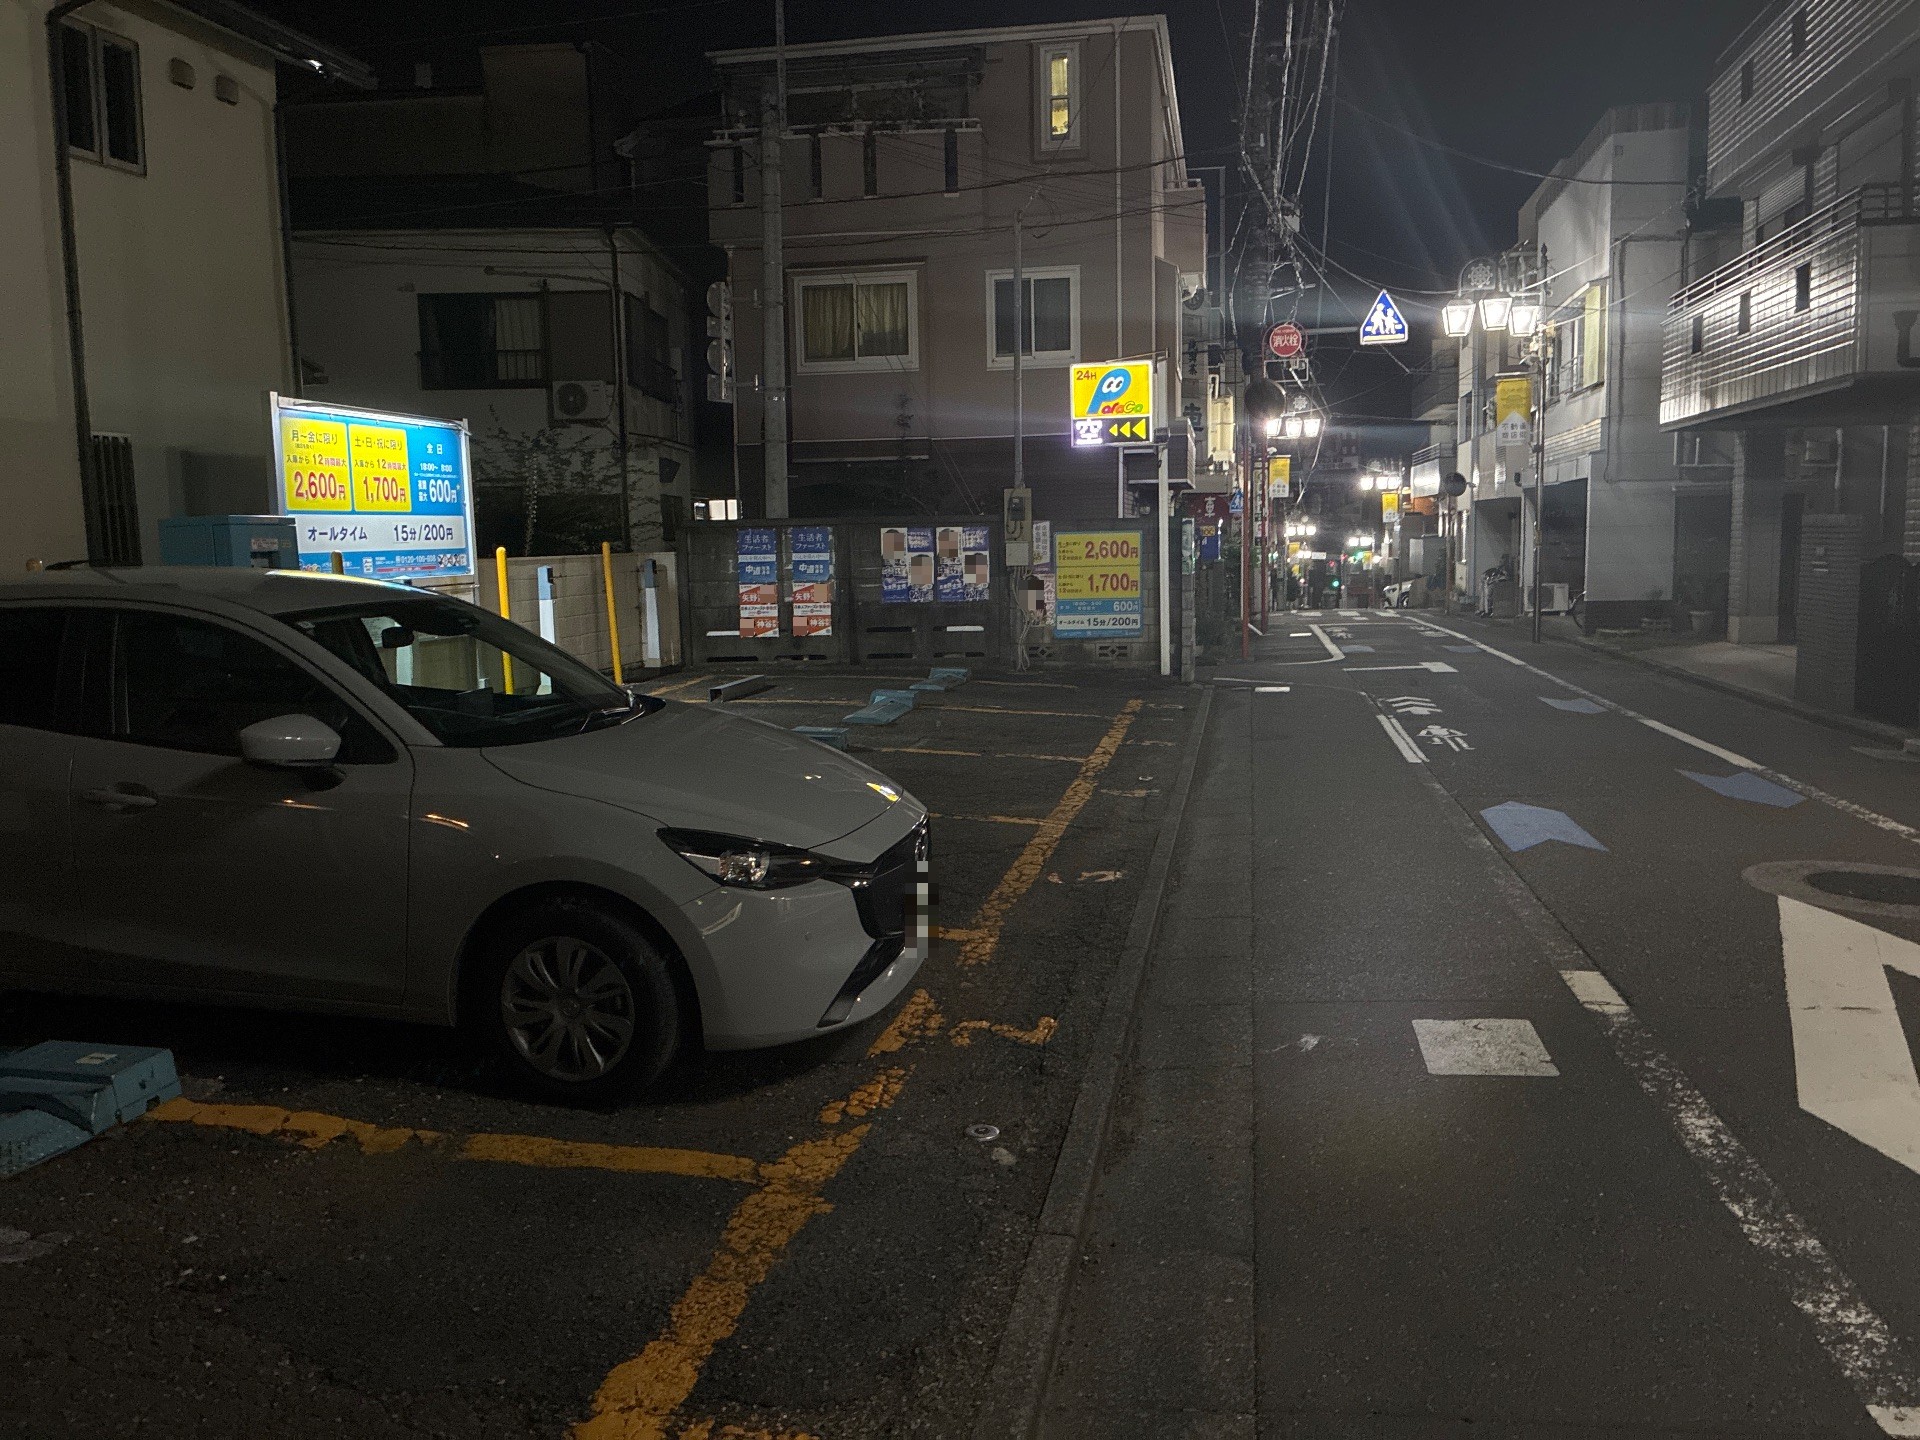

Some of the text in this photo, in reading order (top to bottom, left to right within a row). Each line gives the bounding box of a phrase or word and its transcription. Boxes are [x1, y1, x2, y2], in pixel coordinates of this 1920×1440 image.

[1273, 333, 1298, 347] 消火栓
[1076, 370, 1097, 380] 24H
[1075, 418, 1103, 445] 空
[294, 470, 346, 501] 2,600円
[363, 476, 407, 502] 1,700円
[429, 478, 457, 504] 600円
[307, 524, 454, 542] オールタイム 15分/200円
[744, 534, 770, 543] 生活者
[798, 533, 823, 542] 生活者
[1084, 540, 1139, 560] 2,600円
[1087, 573, 1139, 593] 1,700円
[1113, 601, 1139, 612] 600円
[1087, 617, 1139, 627] 15分/200円
